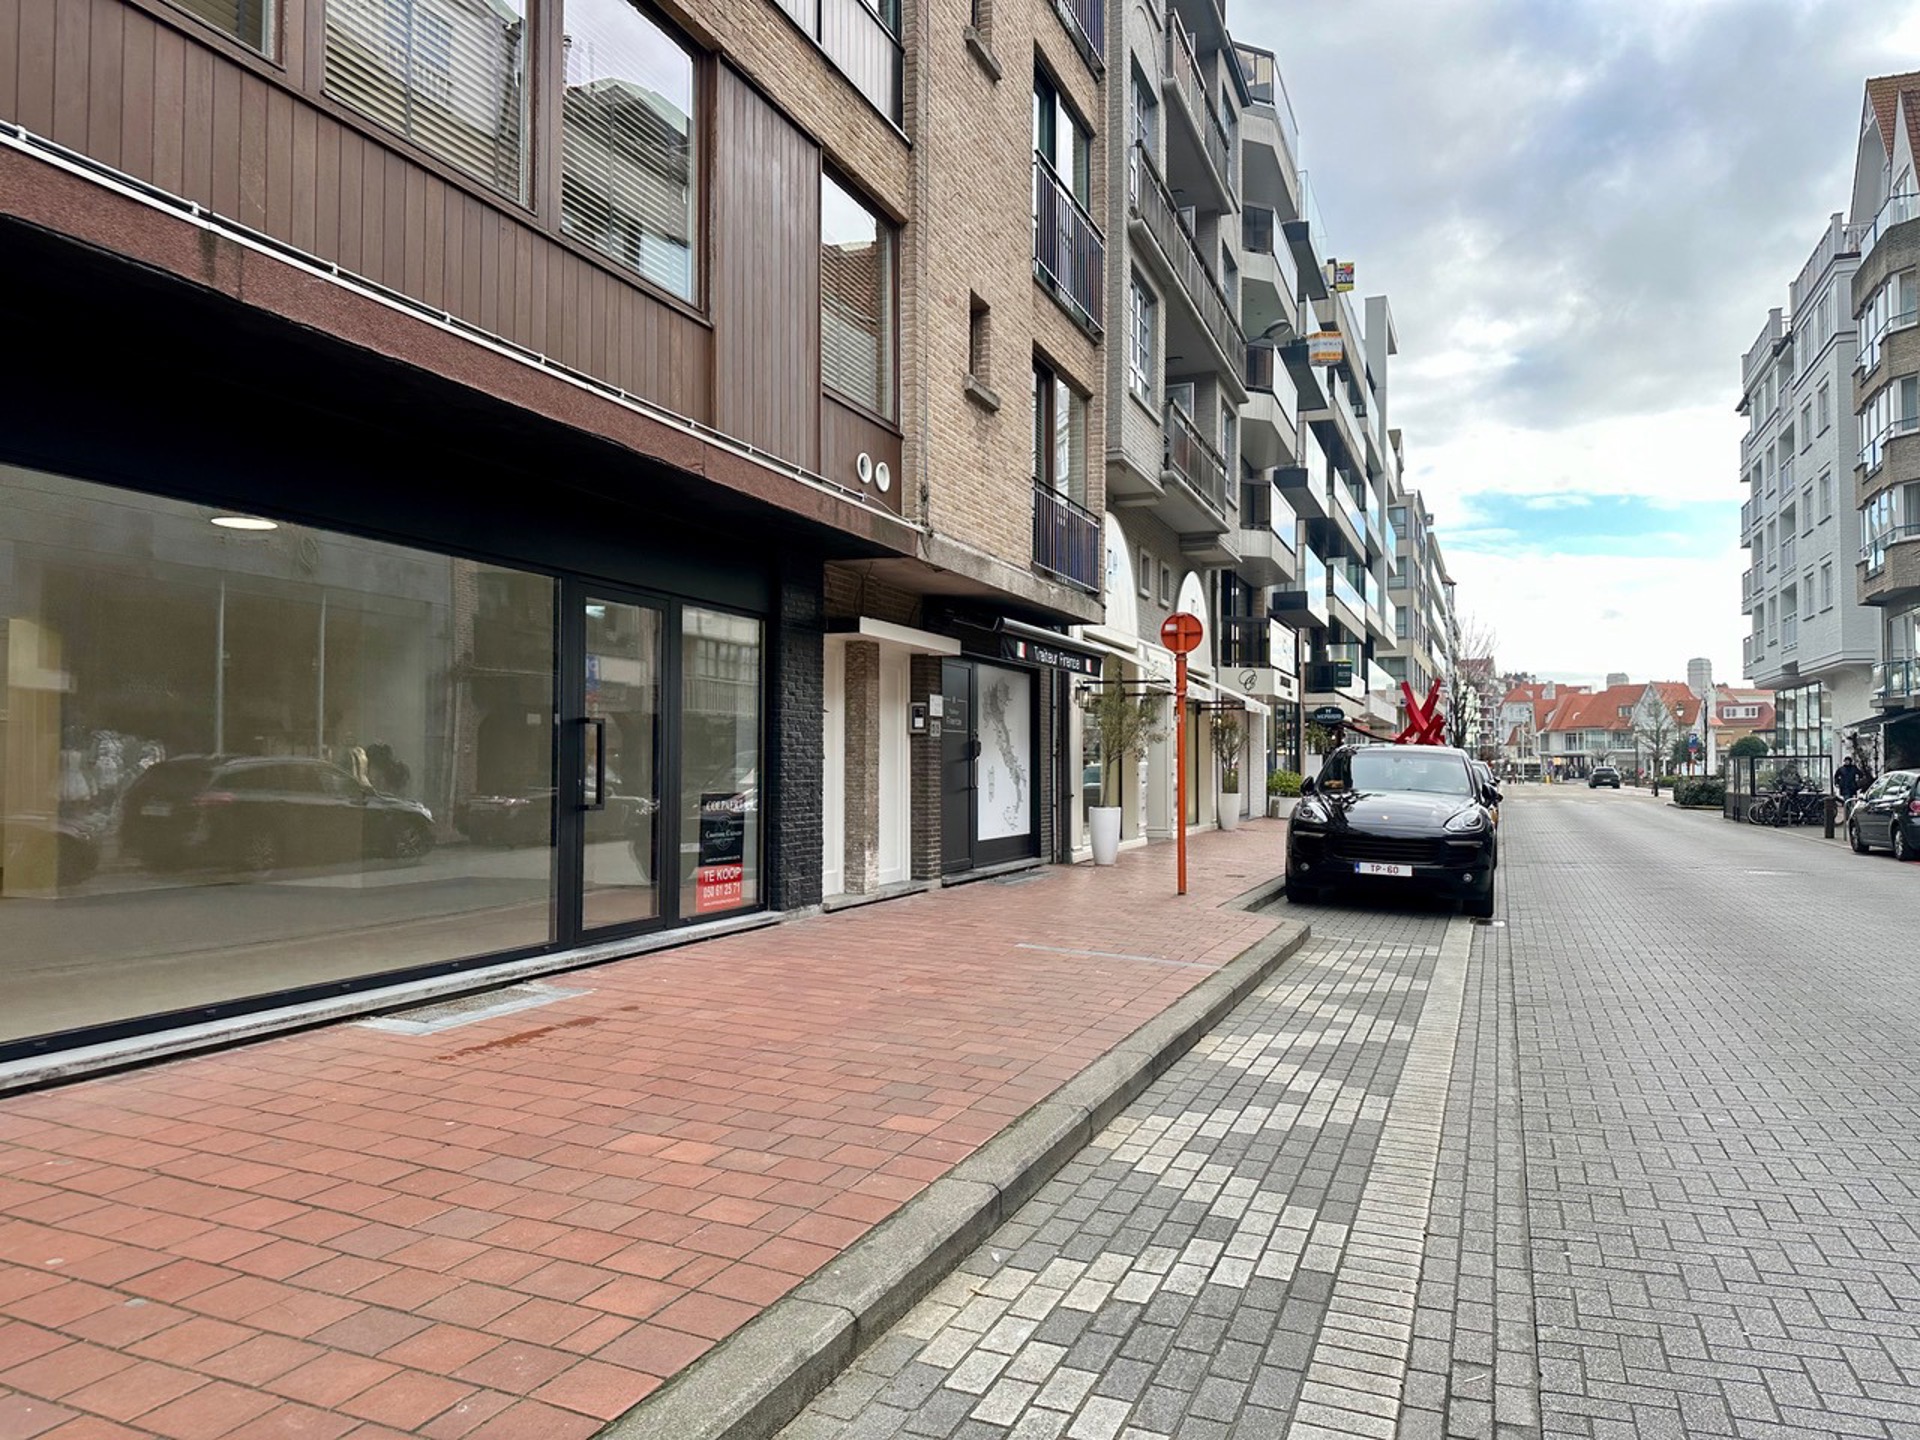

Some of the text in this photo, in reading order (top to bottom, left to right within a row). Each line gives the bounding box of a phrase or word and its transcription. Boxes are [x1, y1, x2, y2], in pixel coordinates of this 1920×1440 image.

[703, 866, 742, 883] TE KOOP
[715, 884, 723, 896] 61
[723, 882, 732, 895] 25
[733, 881, 741, 894] 71
